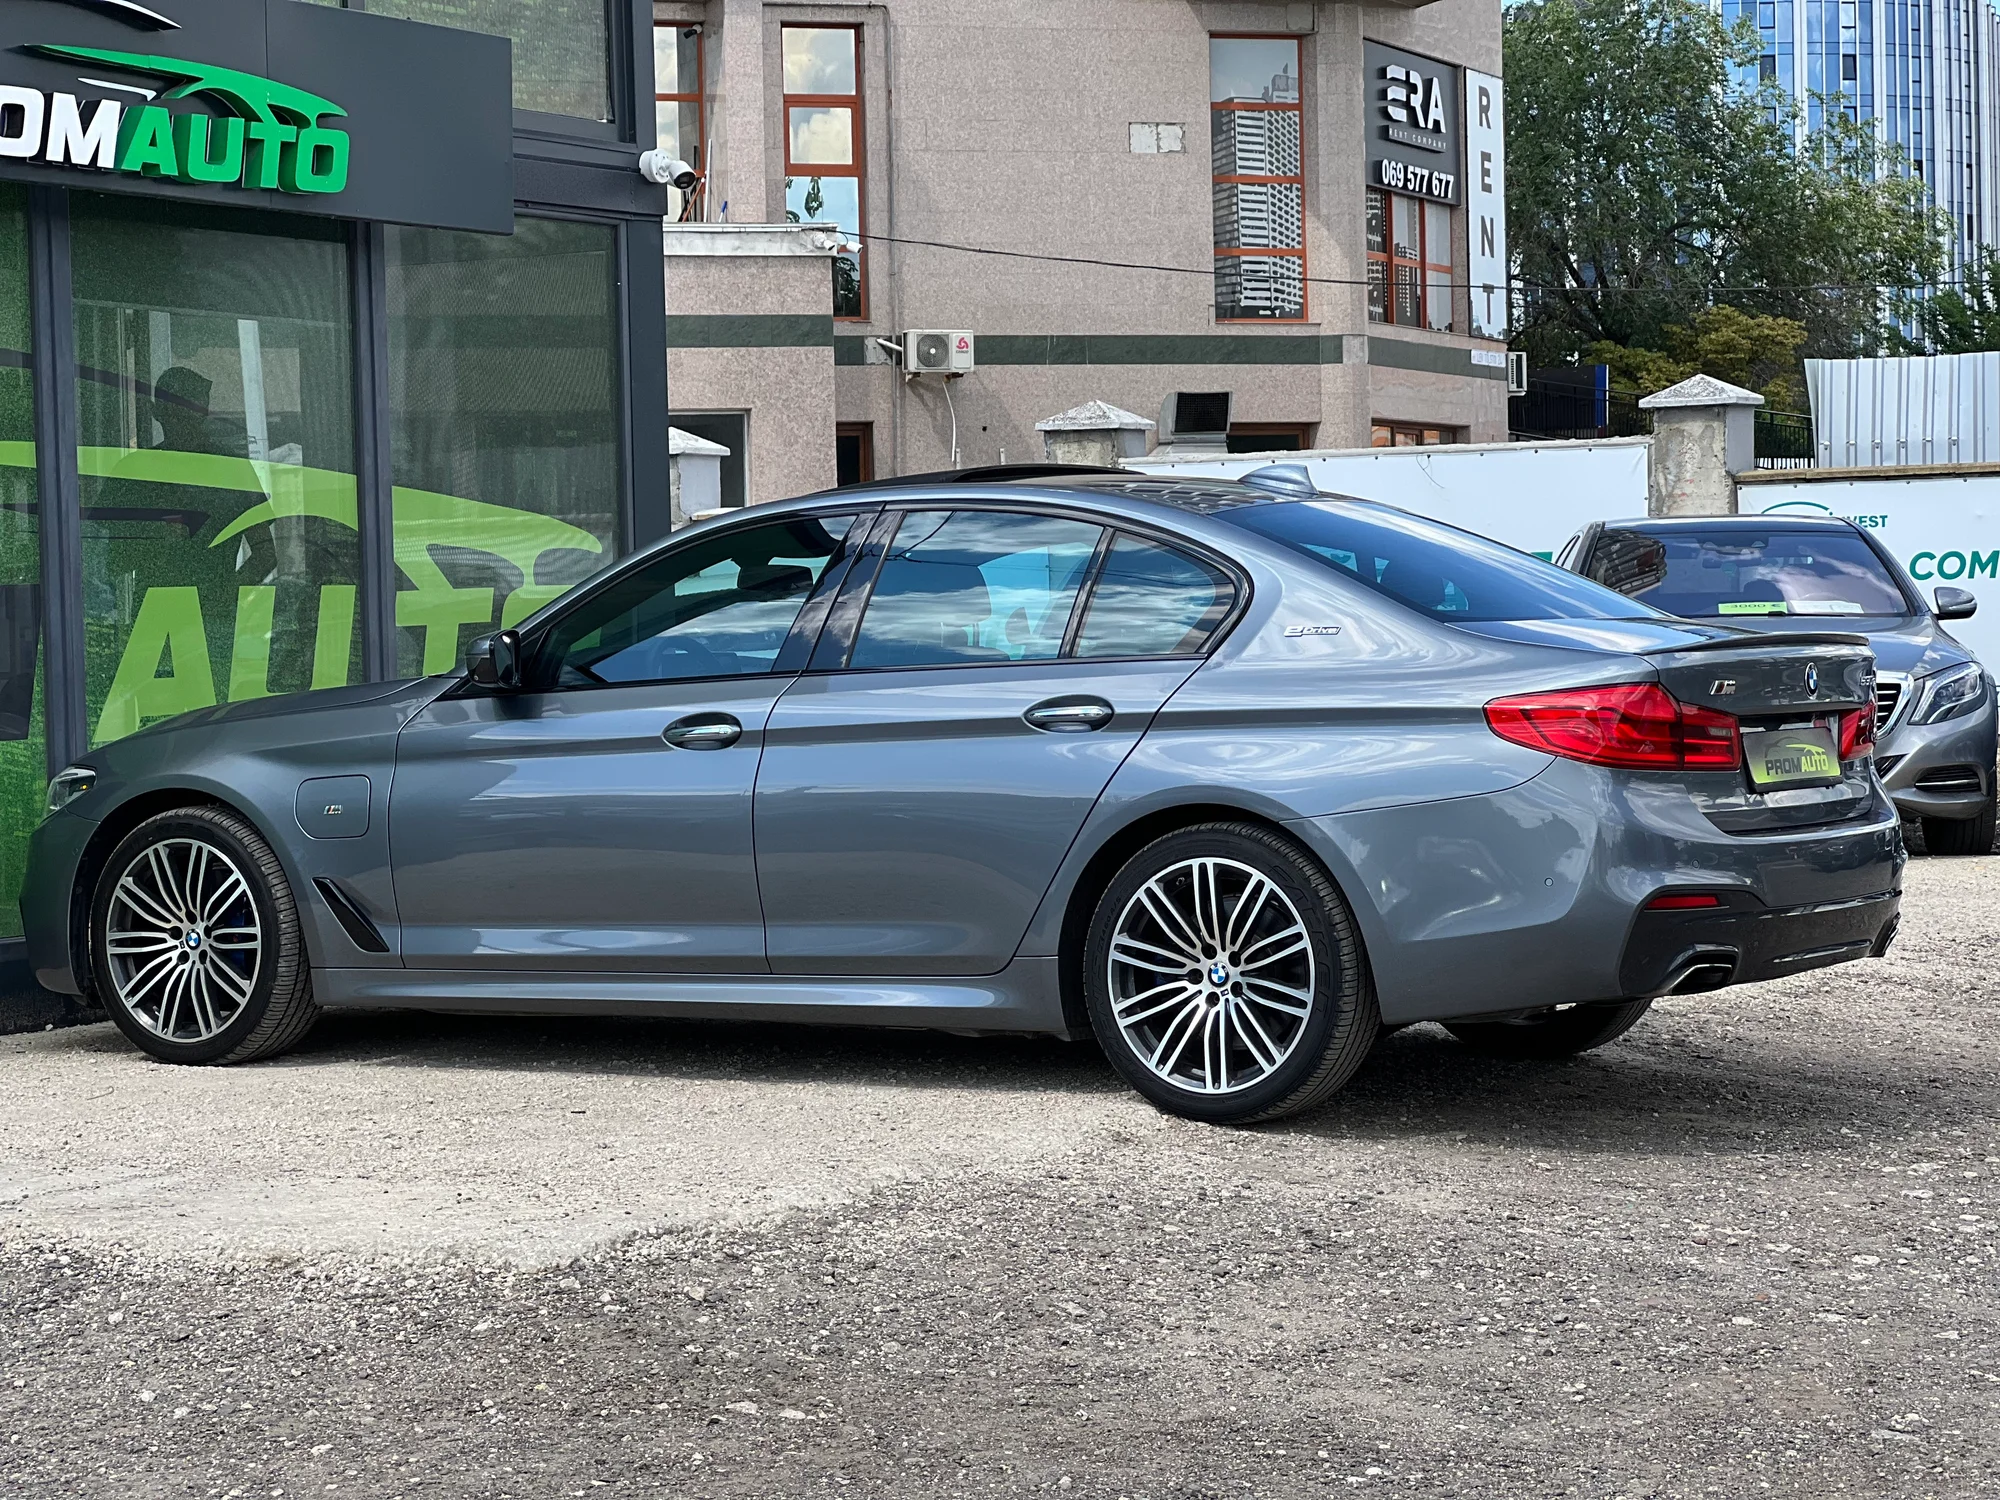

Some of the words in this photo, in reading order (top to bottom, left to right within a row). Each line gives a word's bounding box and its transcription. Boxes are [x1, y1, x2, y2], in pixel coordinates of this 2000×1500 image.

[1387, 64, 1446, 133] ERA
[1389, 128, 1408, 139] RENT
[1412, 135, 1447, 149] COMPANY
[1382, 159, 1404, 188] 069
[1407, 165, 1429, 193] 577
[1432, 171, 1454, 198] 677
[1478, 85, 1495, 325] RENT
[1909, 550, 2000, 581] COM
[95, 584, 576, 744] AUT
[1765, 754, 1829, 776] PROMAUTO
